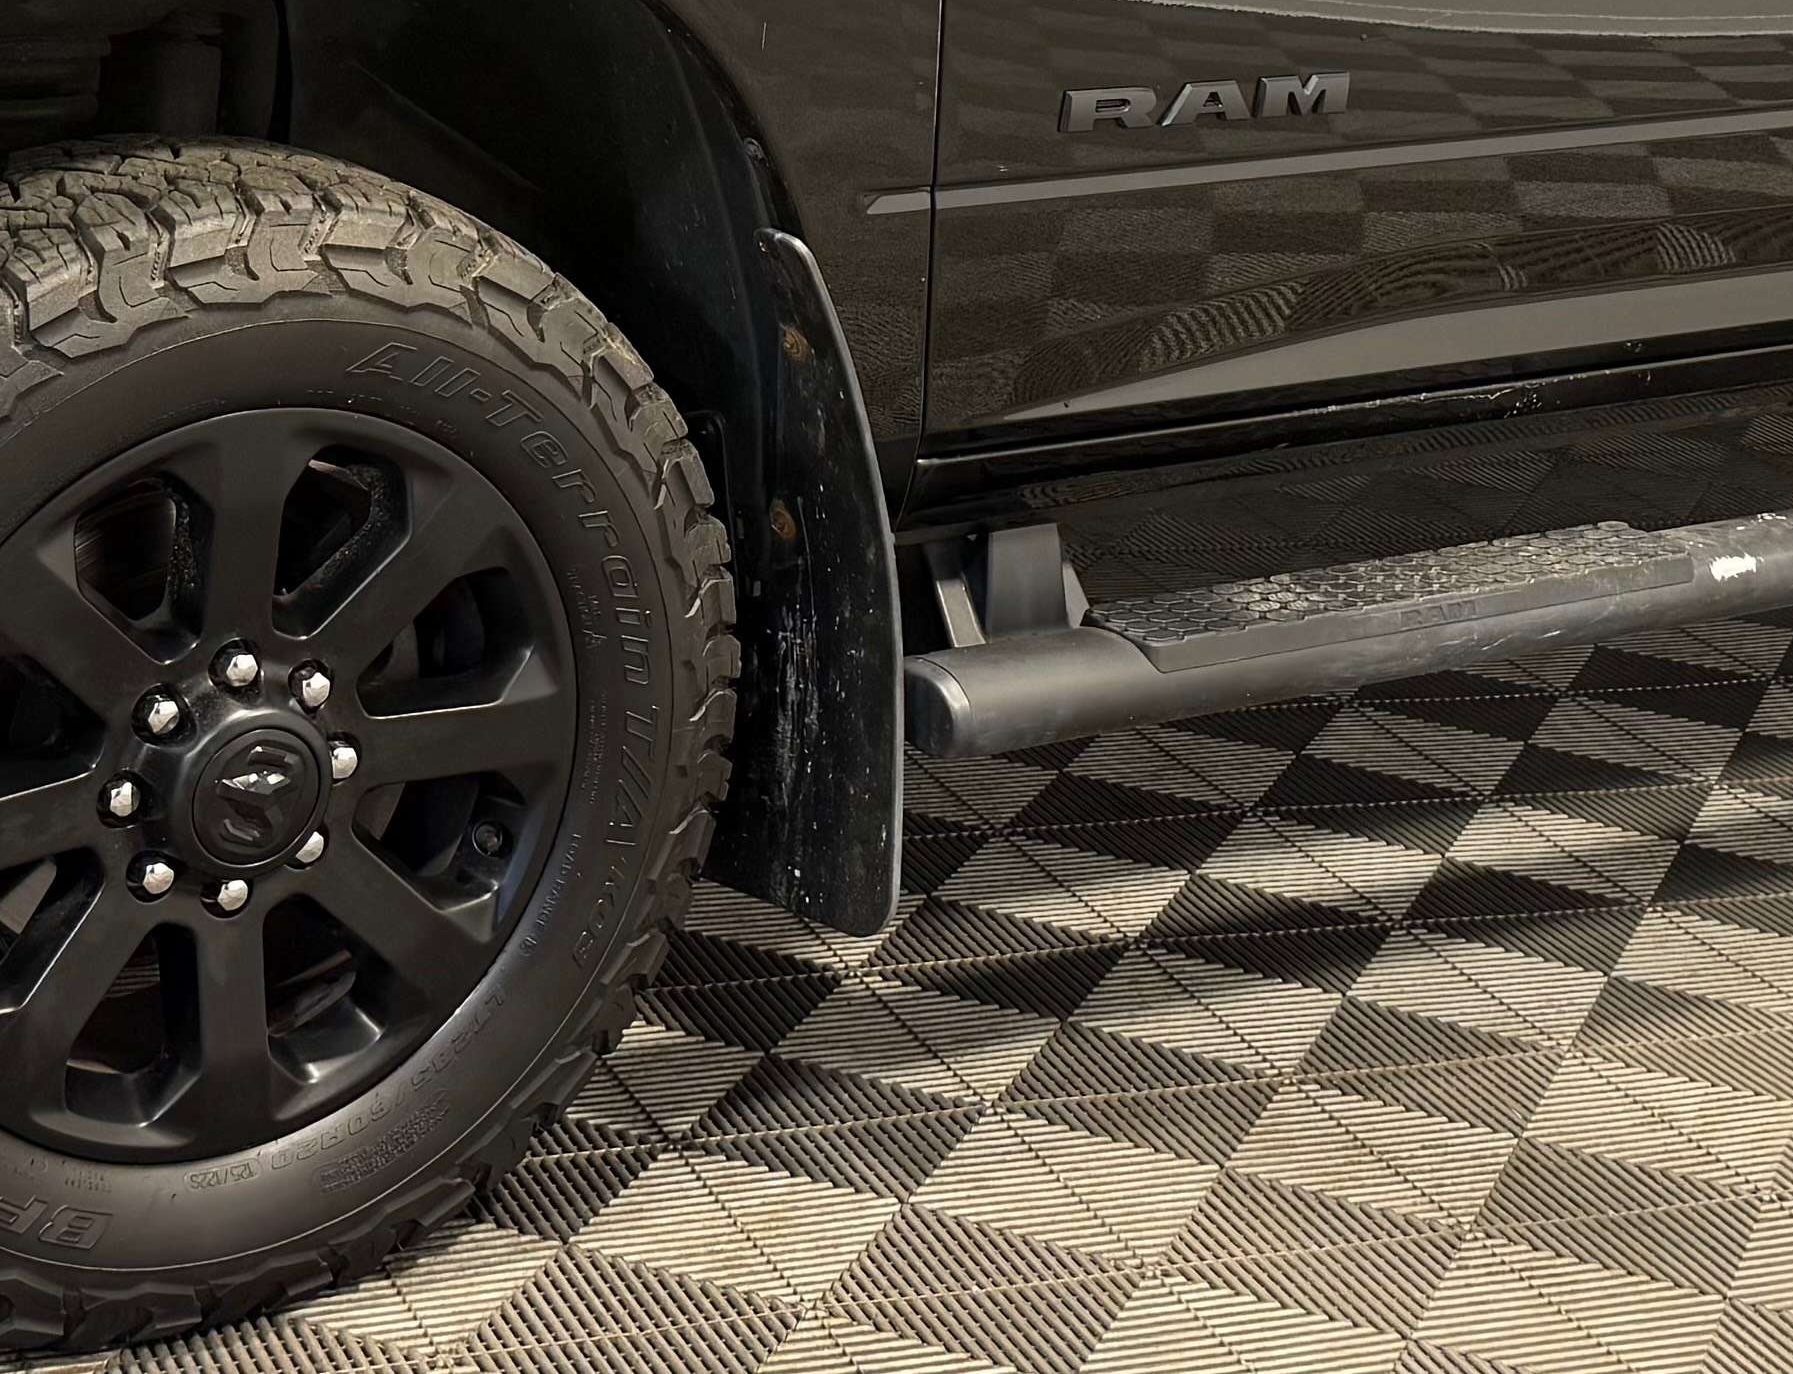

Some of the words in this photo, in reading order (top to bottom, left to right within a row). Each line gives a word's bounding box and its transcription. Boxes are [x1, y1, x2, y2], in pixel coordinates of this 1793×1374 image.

[1058, 72, 1350, 132] RAM
[346, 341, 650, 685] All-Terrain
[1400, 601, 1477, 628] RAM
